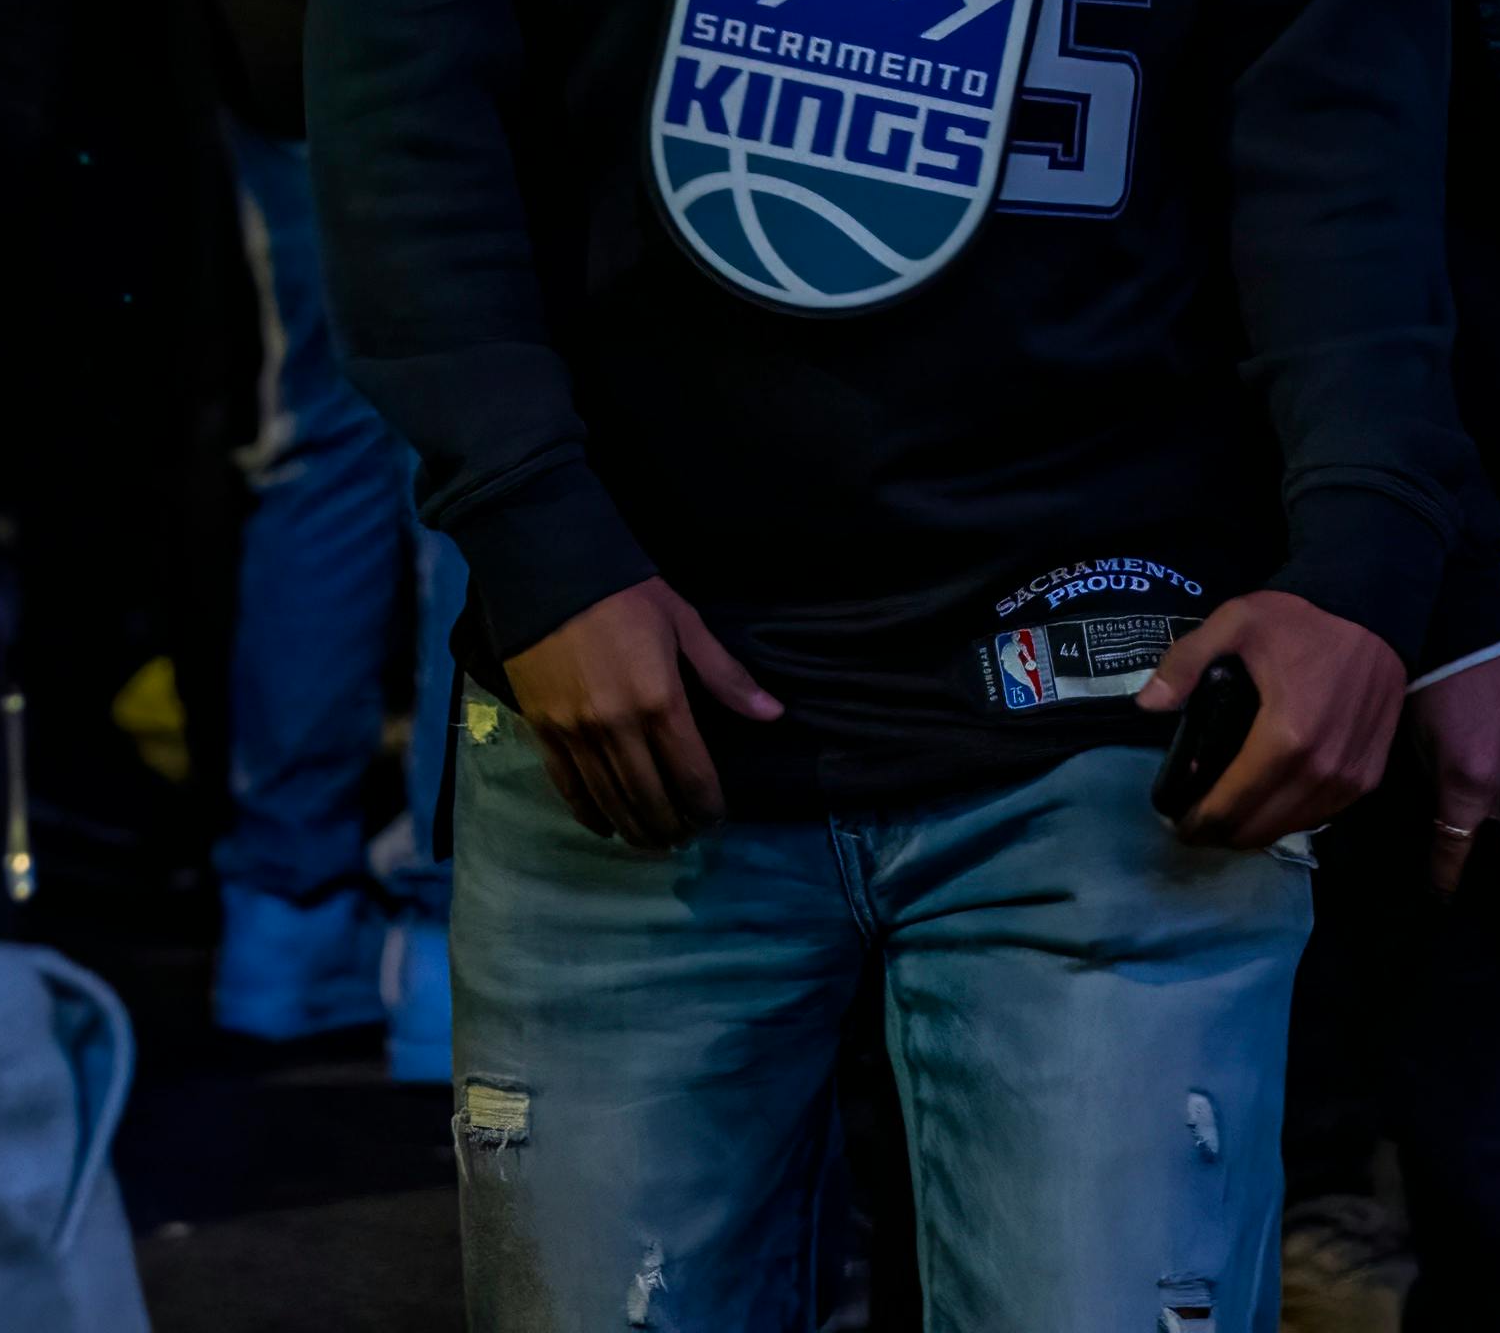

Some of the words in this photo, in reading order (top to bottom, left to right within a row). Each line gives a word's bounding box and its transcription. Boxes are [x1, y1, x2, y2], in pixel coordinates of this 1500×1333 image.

[692, 12, 989, 98] SACRAMENTO
[663, 55, 992, 189] KINGS
[995, 556, 1203, 618] SACRAMENTO
[1044, 574, 1151, 609] PROUD
[1060, 642, 1080, 658] 44
[1010, 685, 1026, 704] 75
